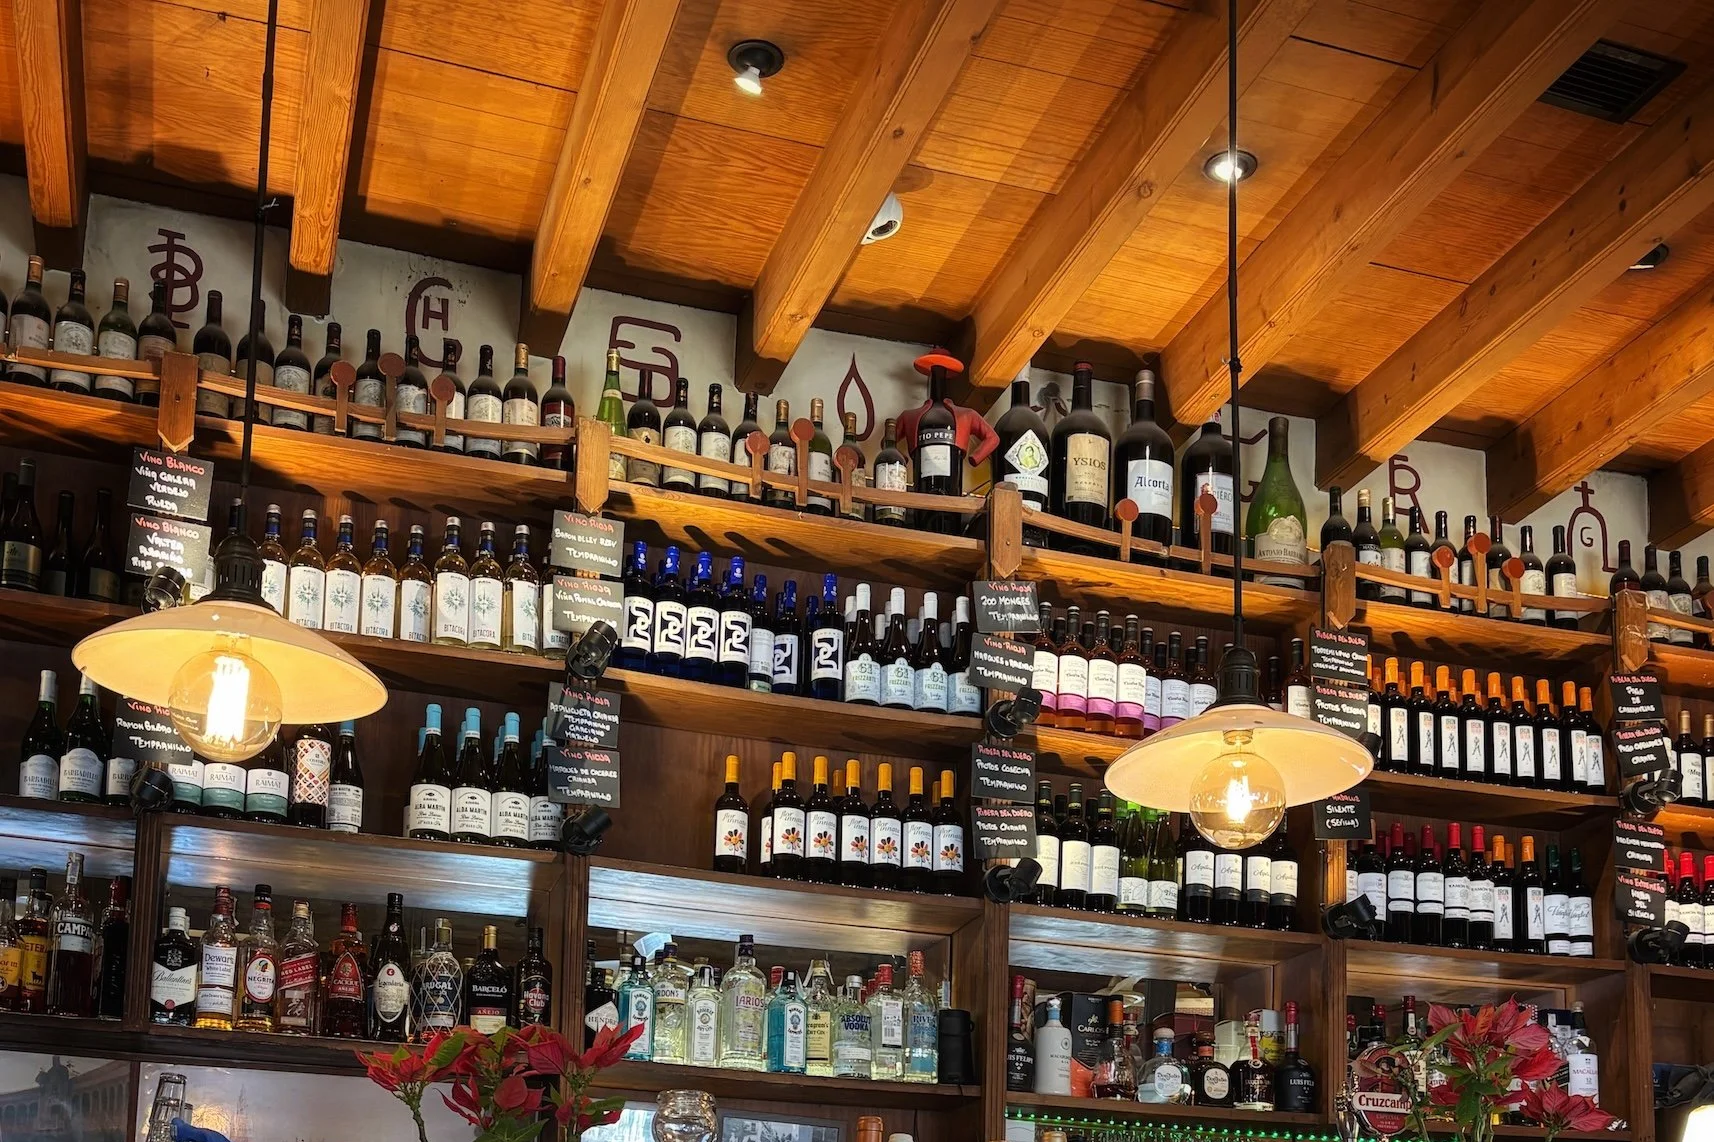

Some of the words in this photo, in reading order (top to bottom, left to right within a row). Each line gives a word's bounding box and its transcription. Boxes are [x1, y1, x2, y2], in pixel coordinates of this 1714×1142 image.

[1072, 457, 1107, 471] YSIOS
[1134, 475, 1170, 493] Alcorta
[57, 922, 93, 937] CAMPA
[844, 1022, 869, 1032] VODKA
[1358, 1094, 1412, 1110] Cruzcamp
